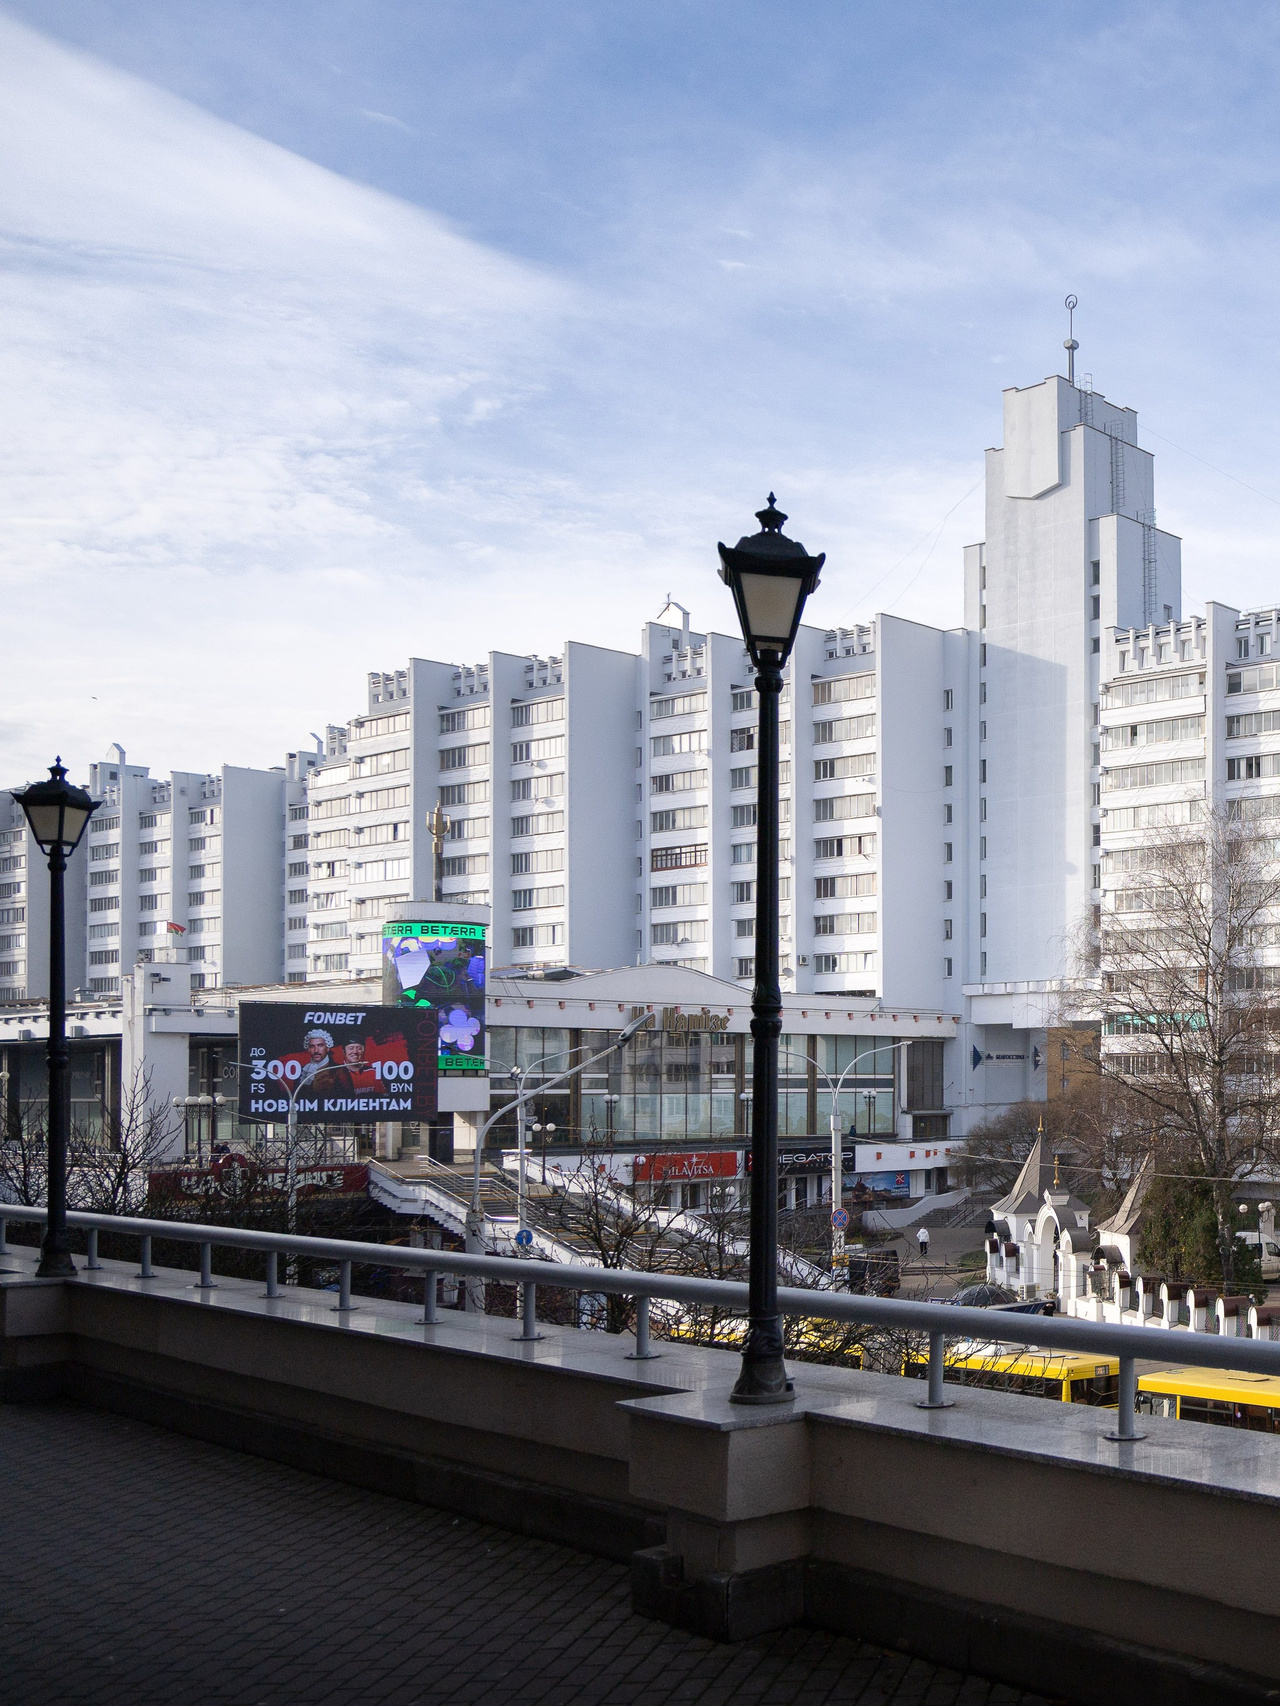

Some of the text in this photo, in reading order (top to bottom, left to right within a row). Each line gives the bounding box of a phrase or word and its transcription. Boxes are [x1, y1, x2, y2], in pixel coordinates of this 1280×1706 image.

[304, 1011, 366, 1025] FONBET
[663, 1007, 730, 1032] Нямізе
[250, 1048, 266, 1058] ДО
[222, 1066, 238, 1078] CO
[250, 1060, 300, 1080] 300
[371, 1060, 414, 1080] 100
[250, 1083, 265, 1093] FS
[390, 1083, 413, 1093] BYN
[250, 1098, 412, 1113] НОВЫМ КЛИЕНТАМ
[777, 1152, 853, 1164] EGATP
